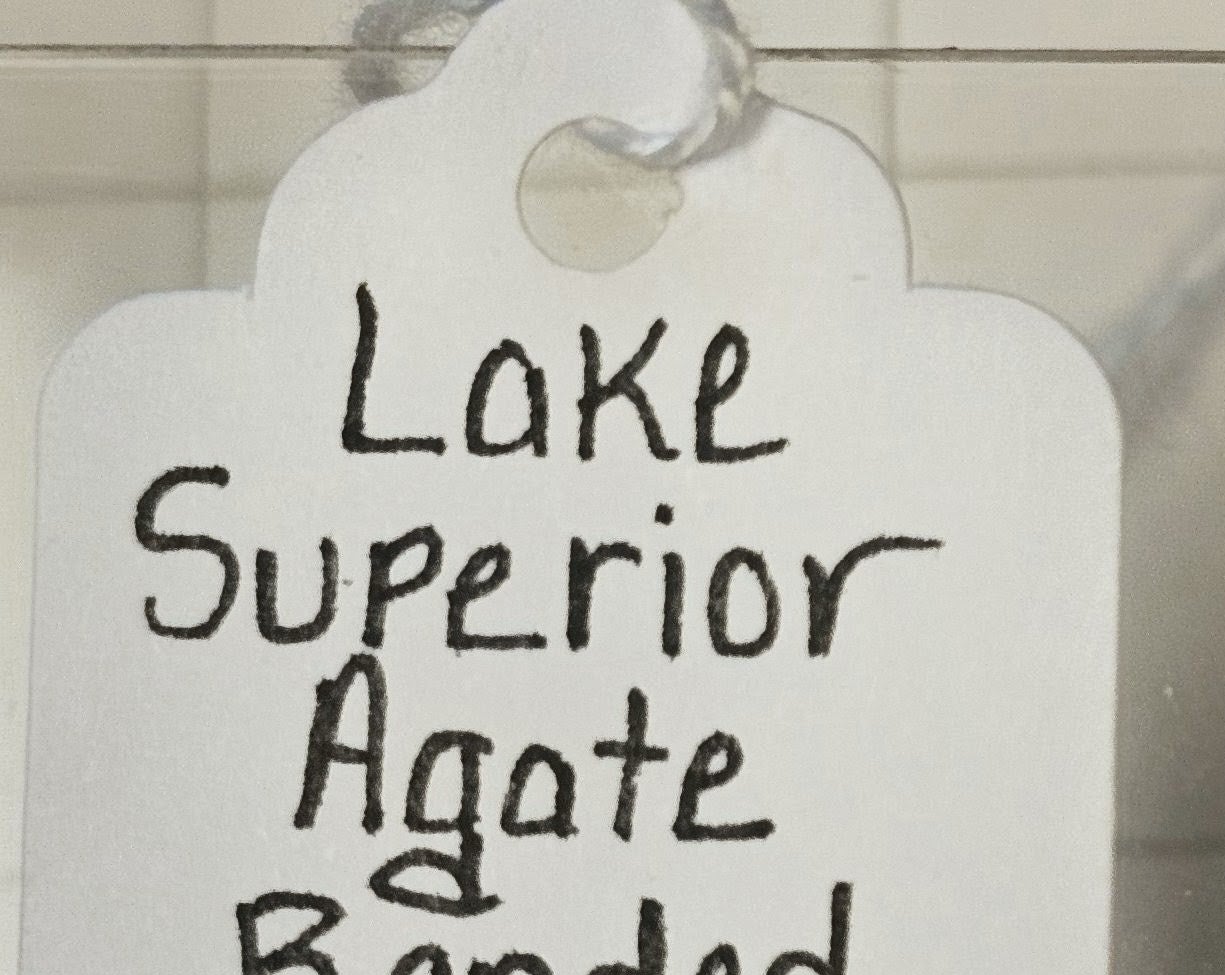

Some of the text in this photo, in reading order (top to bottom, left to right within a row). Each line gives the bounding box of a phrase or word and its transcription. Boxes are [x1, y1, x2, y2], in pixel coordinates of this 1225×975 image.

[341, 282, 787, 464] Lake
[133, 464, 942, 658] Superior
[293, 652, 775, 919] Agate
